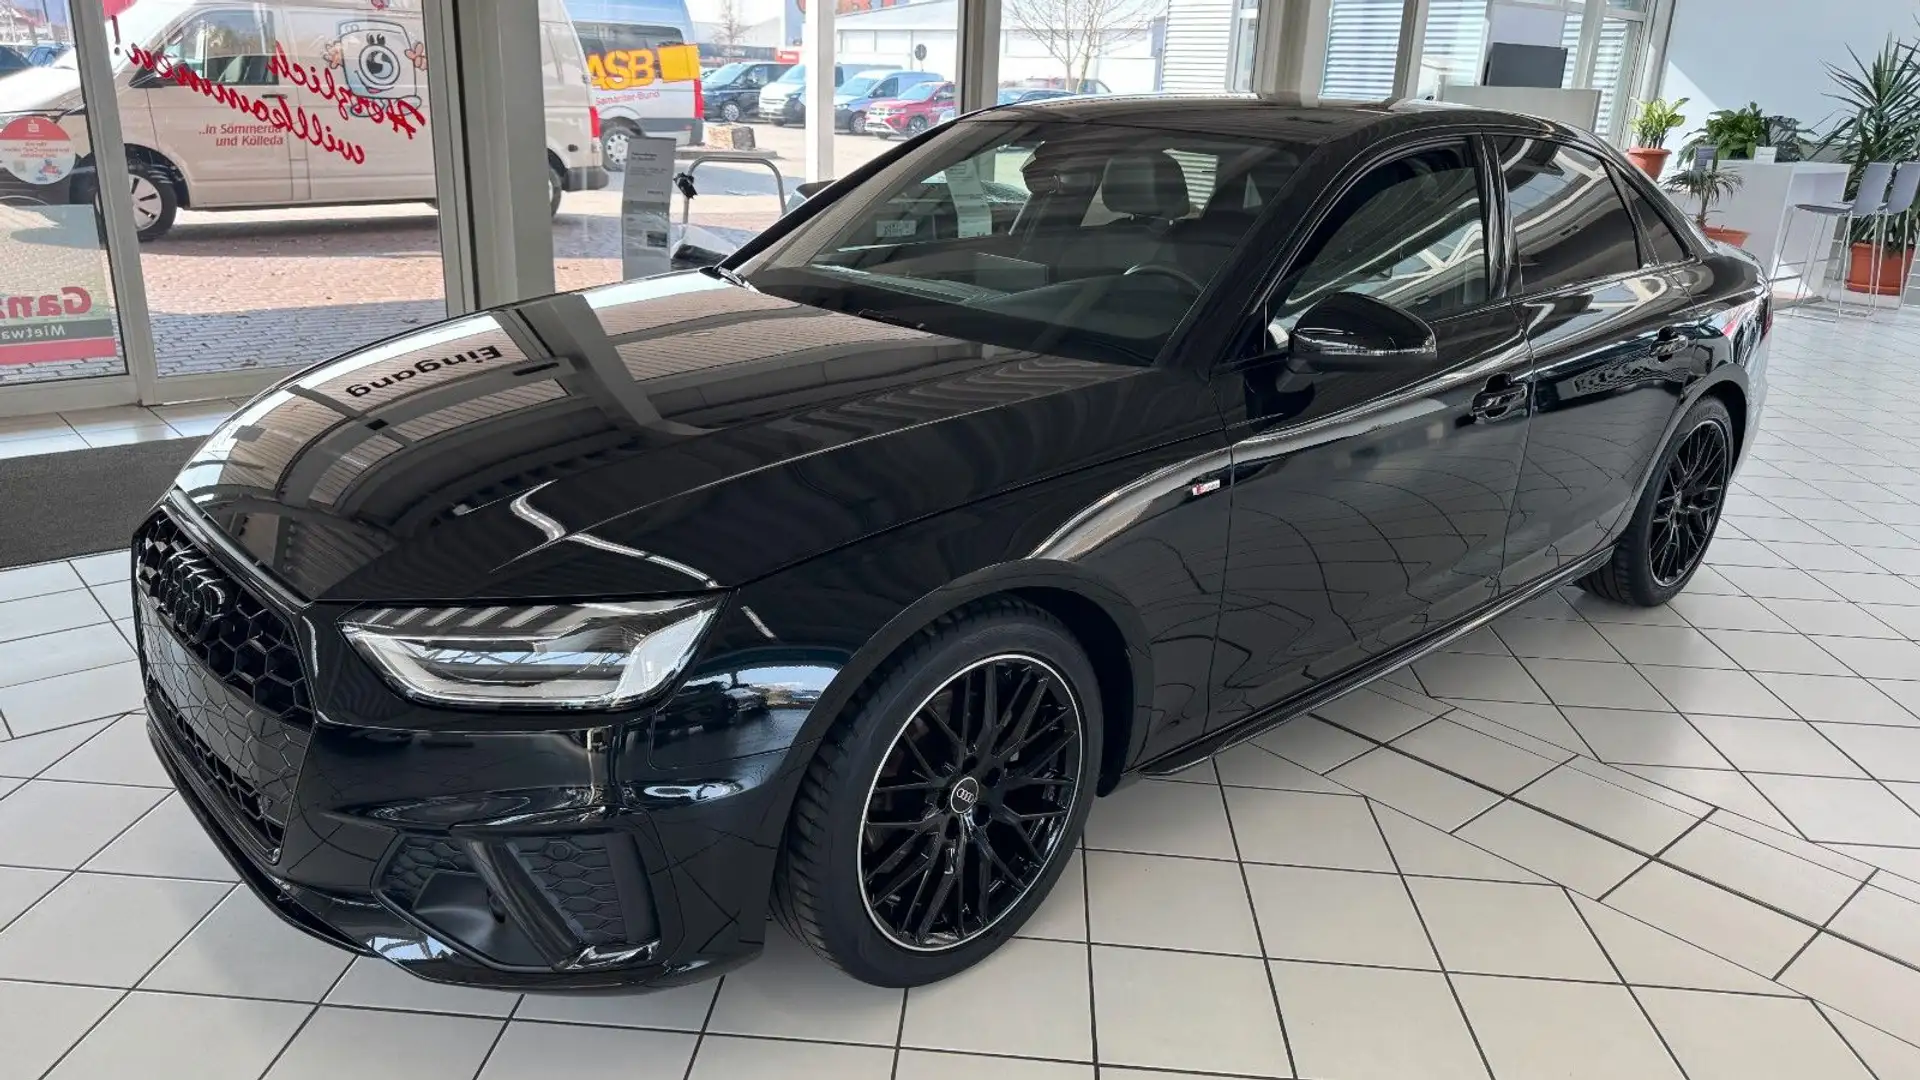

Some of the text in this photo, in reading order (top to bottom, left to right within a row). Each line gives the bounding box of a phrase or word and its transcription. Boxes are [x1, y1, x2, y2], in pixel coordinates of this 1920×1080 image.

[586, 48, 655, 90] ASB
[216, 134, 284, 147] und Kölleda
[346, 345, 503, 397] Eingang
